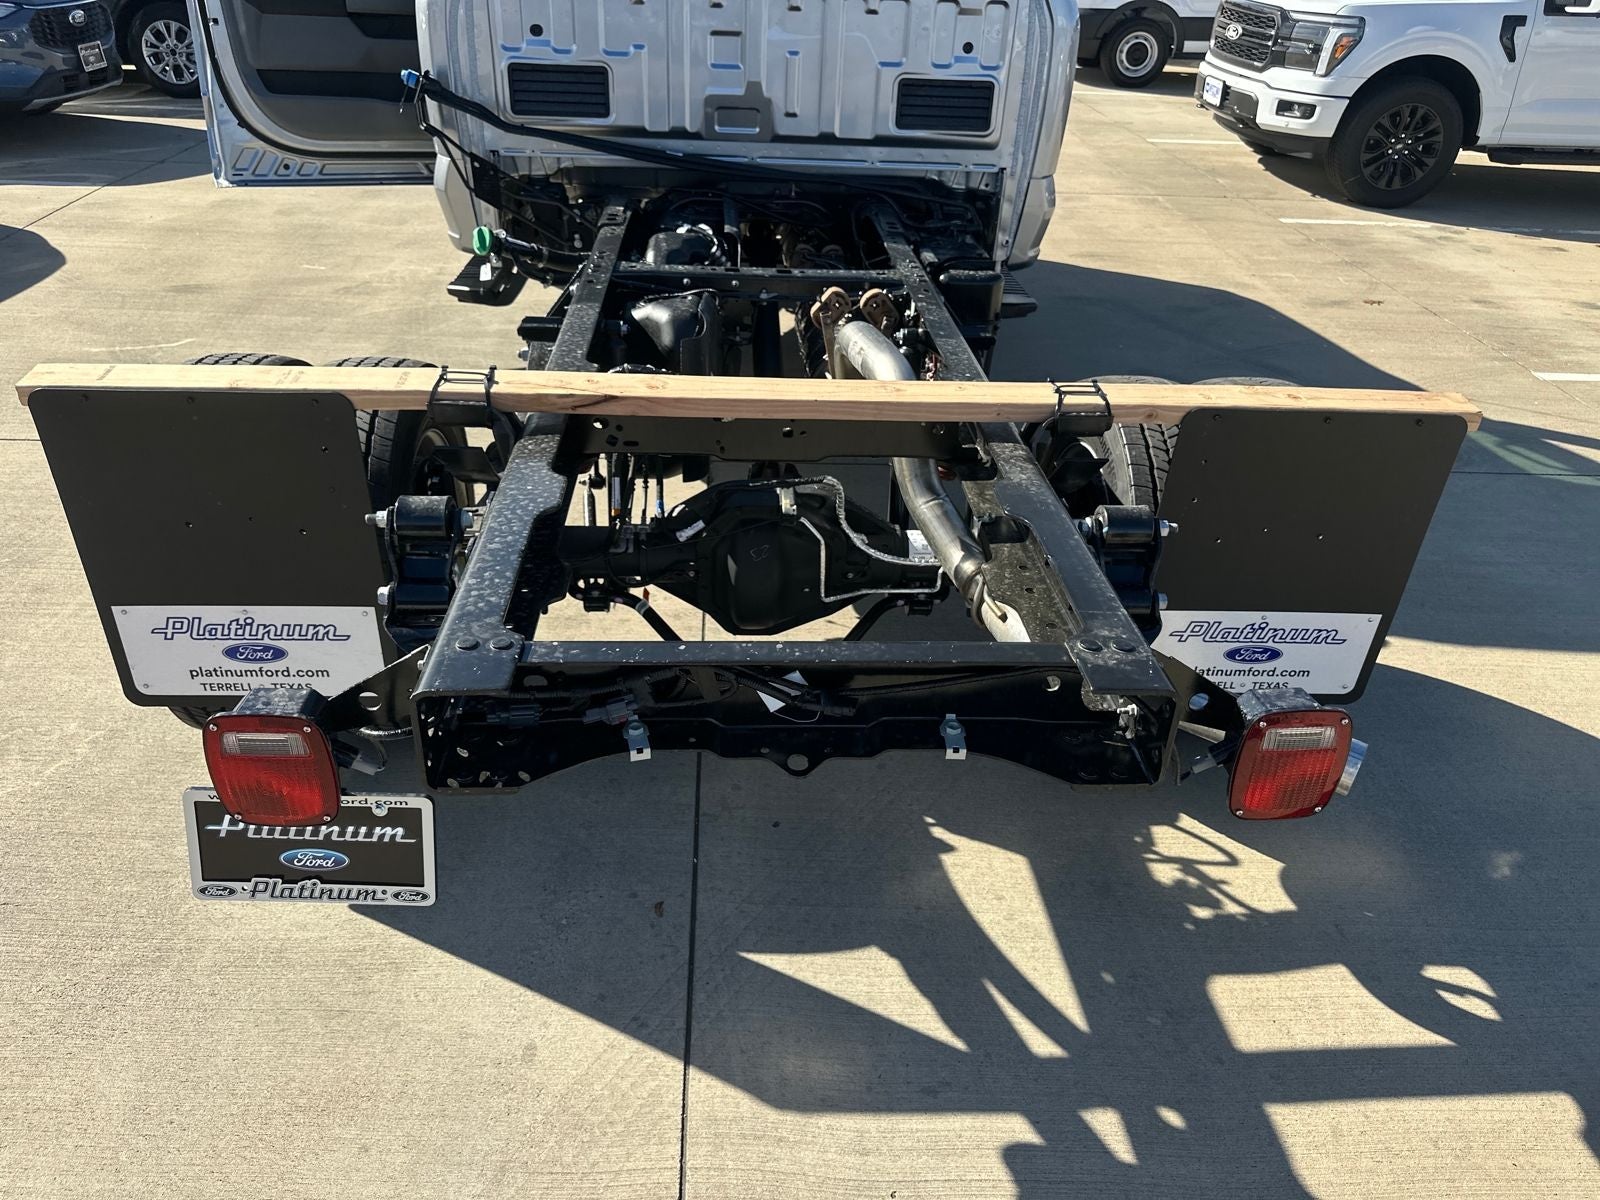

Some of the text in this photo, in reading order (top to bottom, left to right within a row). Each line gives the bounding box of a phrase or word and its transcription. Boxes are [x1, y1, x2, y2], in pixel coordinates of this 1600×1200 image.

[151, 616, 351, 642] Platinum
[1169, 620, 1348, 645] Platinum
[236, 645, 274, 661] Ford
[1234, 647, 1270, 662] Ford
[189, 666, 330, 680] platinumford.com
[1194, 666, 1311, 678] latinumford.com
[1251, 681, 1289, 690] TEXAS
[293, 851, 336, 869] Ford
[204, 879, 424, 902] Ford Platinum Ford
